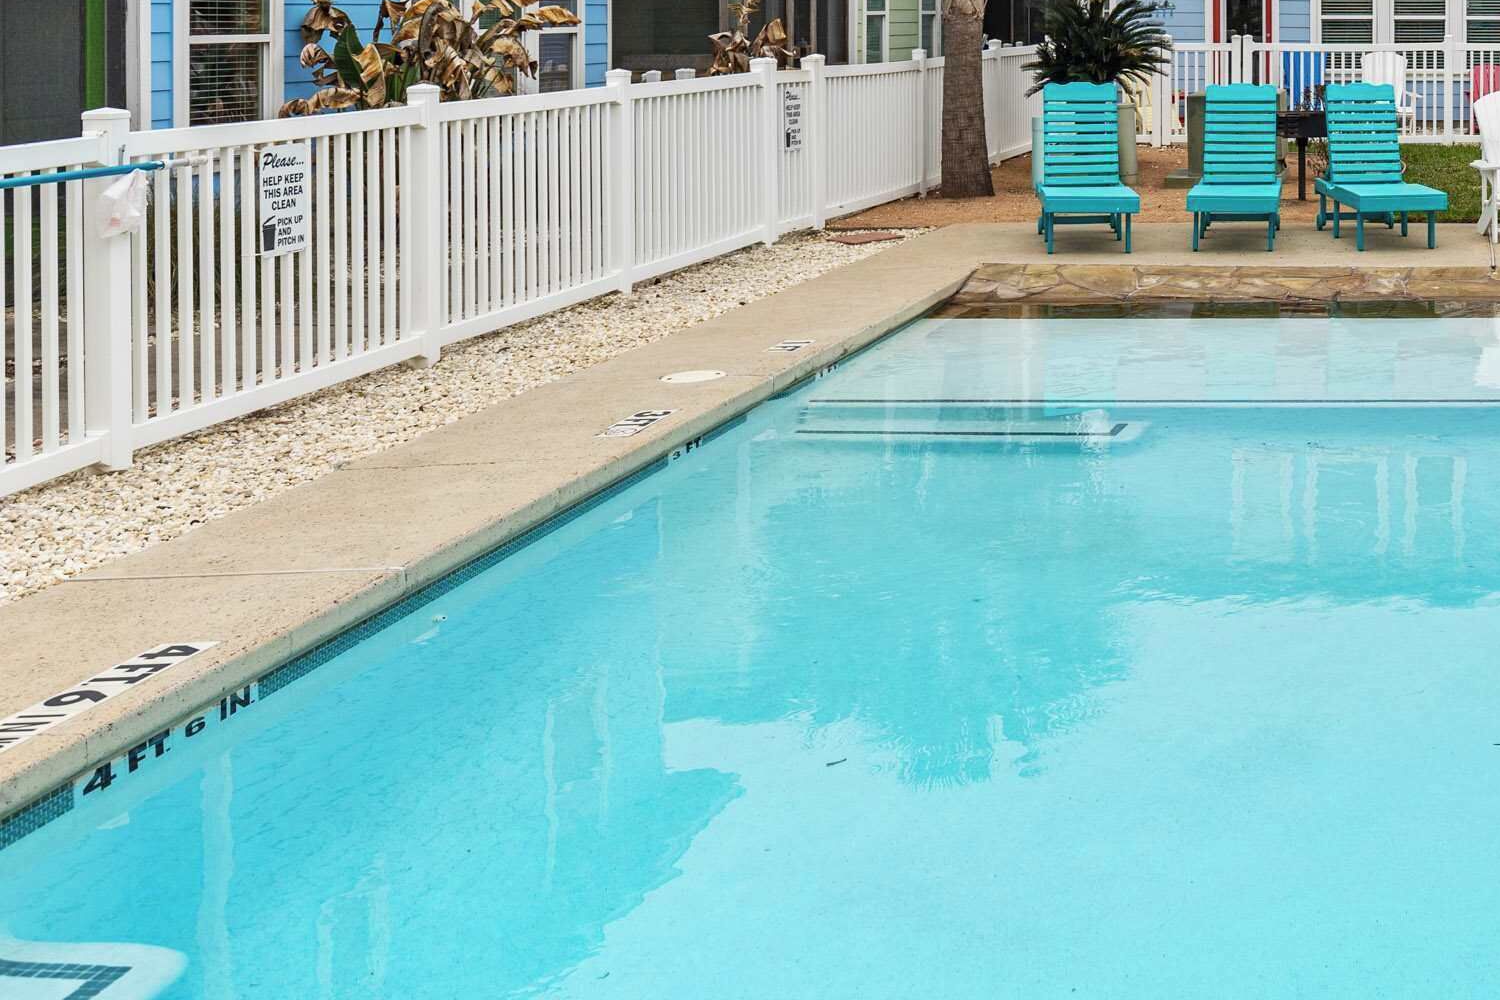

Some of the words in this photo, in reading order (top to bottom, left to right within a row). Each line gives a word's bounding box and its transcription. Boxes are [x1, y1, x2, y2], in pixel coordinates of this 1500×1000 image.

[262, 175, 283, 187] HELP
[284, 172, 304, 184] KEEP
[263, 188, 281, 199] THIS
[283, 185, 304, 197] AREA
[271, 198, 297, 211] CLEAN
[277, 217, 293, 227] PICK
[294, 215, 303, 224] UP
[278, 227, 292, 236] AND
[277, 235, 296, 247] PITCH
[297, 234, 304, 243] IN
[686, 436, 702, 454] FT
[139, 645, 200, 660] 4
[43, 689, 108, 707] 6
[83, 761, 117, 796] 4
[185, 716, 206, 738] 6
